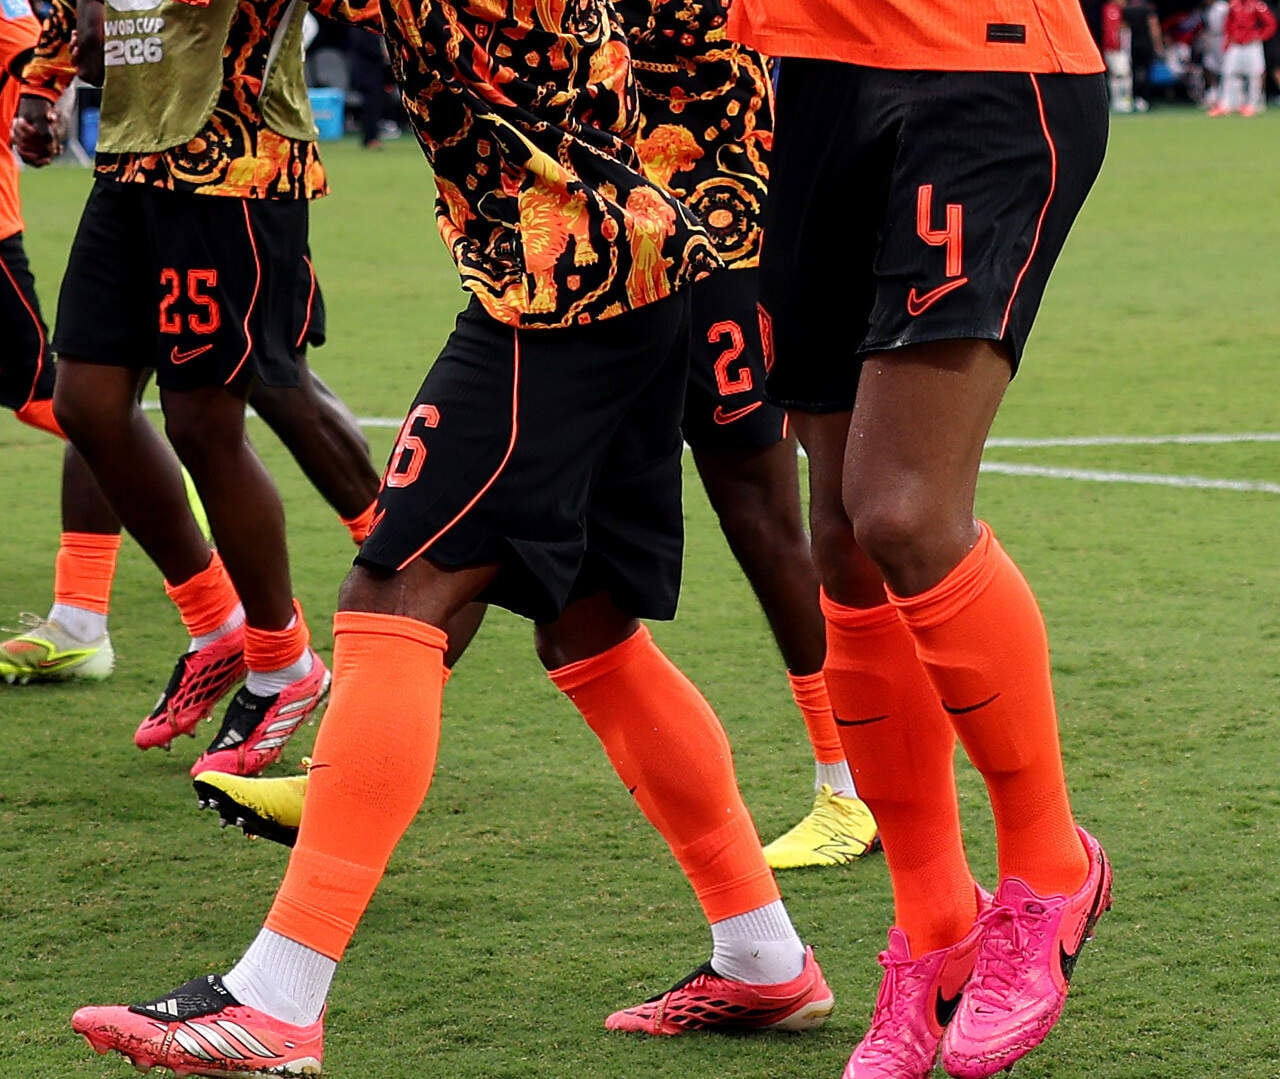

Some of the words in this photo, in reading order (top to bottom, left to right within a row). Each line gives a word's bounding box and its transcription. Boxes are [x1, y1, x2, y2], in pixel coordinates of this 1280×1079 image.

[136, 17, 166, 34] CUP
[916, 183, 964, 278] 4
[158, 267, 221, 335] 25
[707, 319, 753, 397] 2
